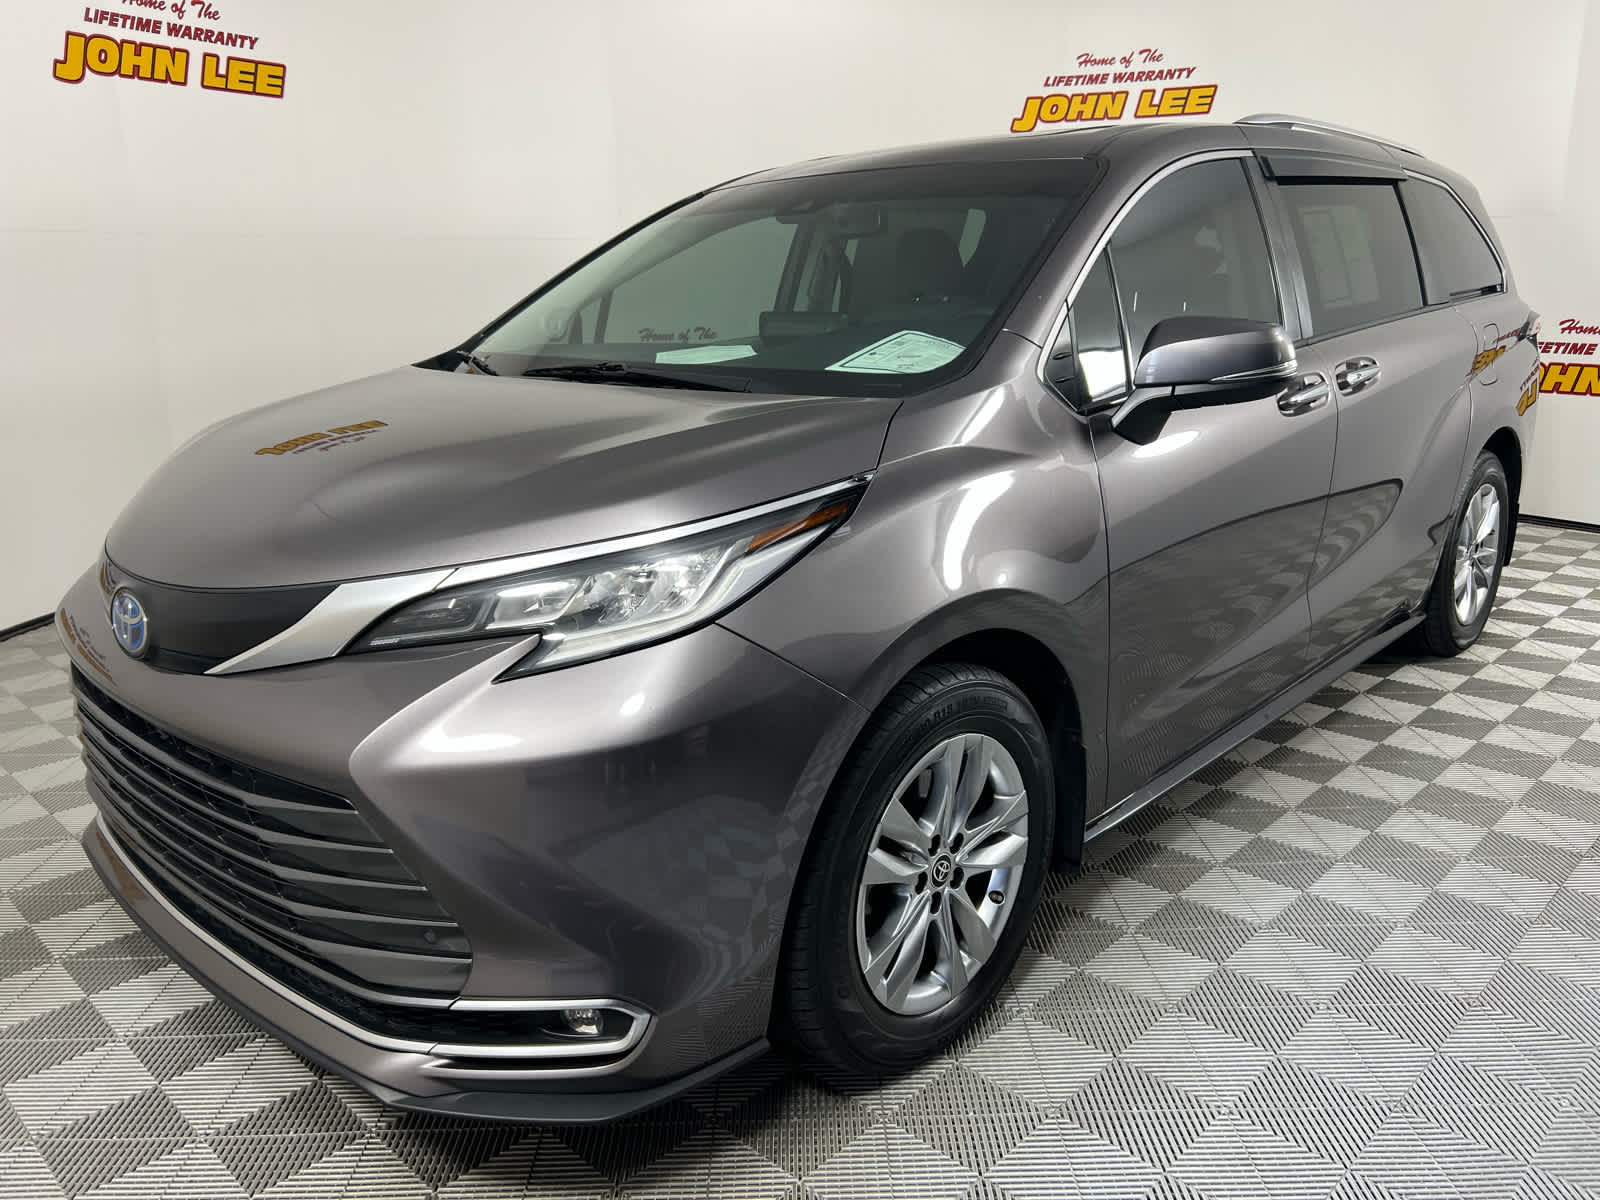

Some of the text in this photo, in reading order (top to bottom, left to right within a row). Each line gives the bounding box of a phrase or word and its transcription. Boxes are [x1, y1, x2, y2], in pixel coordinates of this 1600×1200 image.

[171, 0, 186, 20] of
[191, 0, 220, 21] The
[84, 7, 259, 50] LIFETIME WARRANTY
[53, 31, 286, 99] JOHN LEE
[1076, 48, 1164, 69] Home of The
[1044, 67, 1197, 87] LIFETIME WARRANTY
[1010, 84, 1218, 132] JOHN LEE
[1559, 319, 1600, 335] Hom
[1538, 342, 1598, 355] ETIME
[1539, 362, 1600, 397] HN
